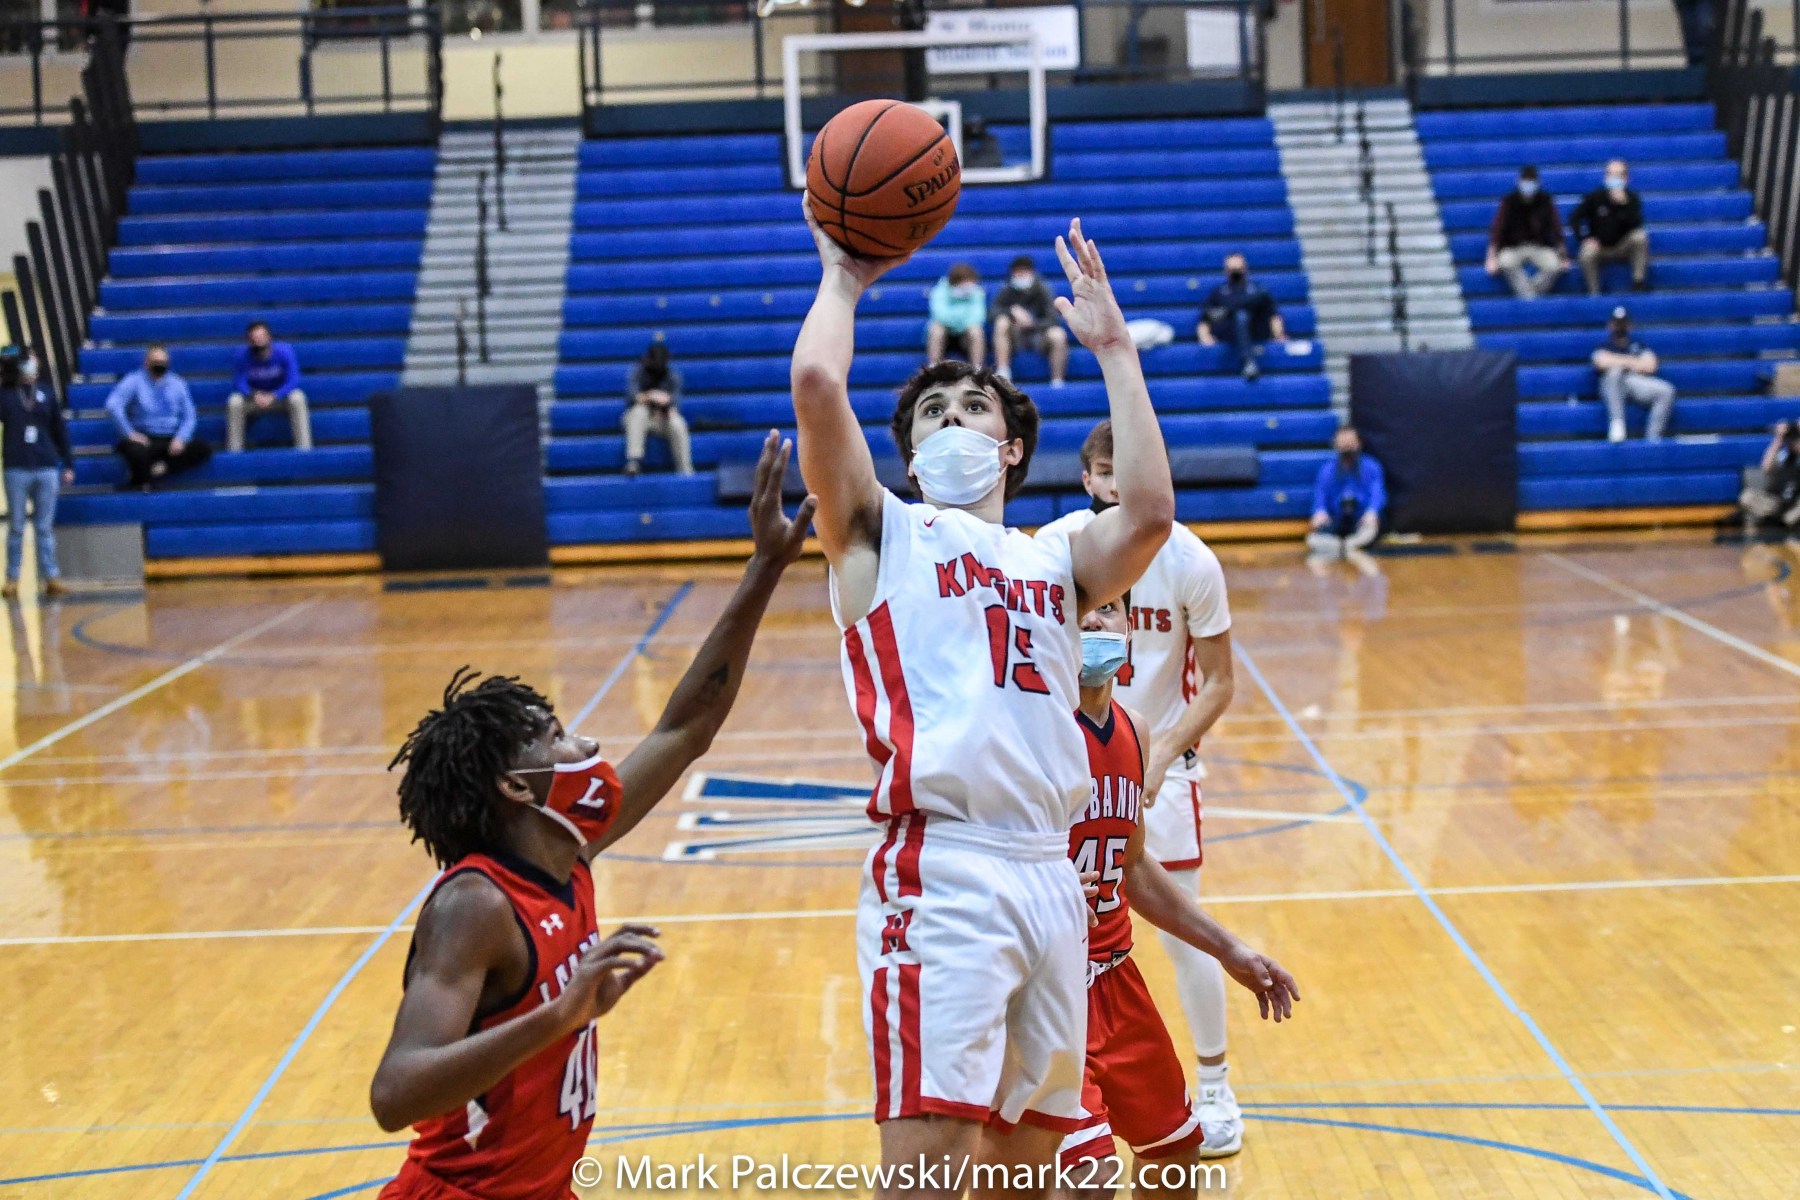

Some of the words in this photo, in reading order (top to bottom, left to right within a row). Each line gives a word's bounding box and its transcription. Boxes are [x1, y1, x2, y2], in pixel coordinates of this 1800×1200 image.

[903, 157, 960, 208] SPALD
[934, 551, 1066, 626] KNGHTS
[984, 603, 1051, 695] 15
[576, 776, 606, 809] L
[1072, 835, 1129, 914] 45
